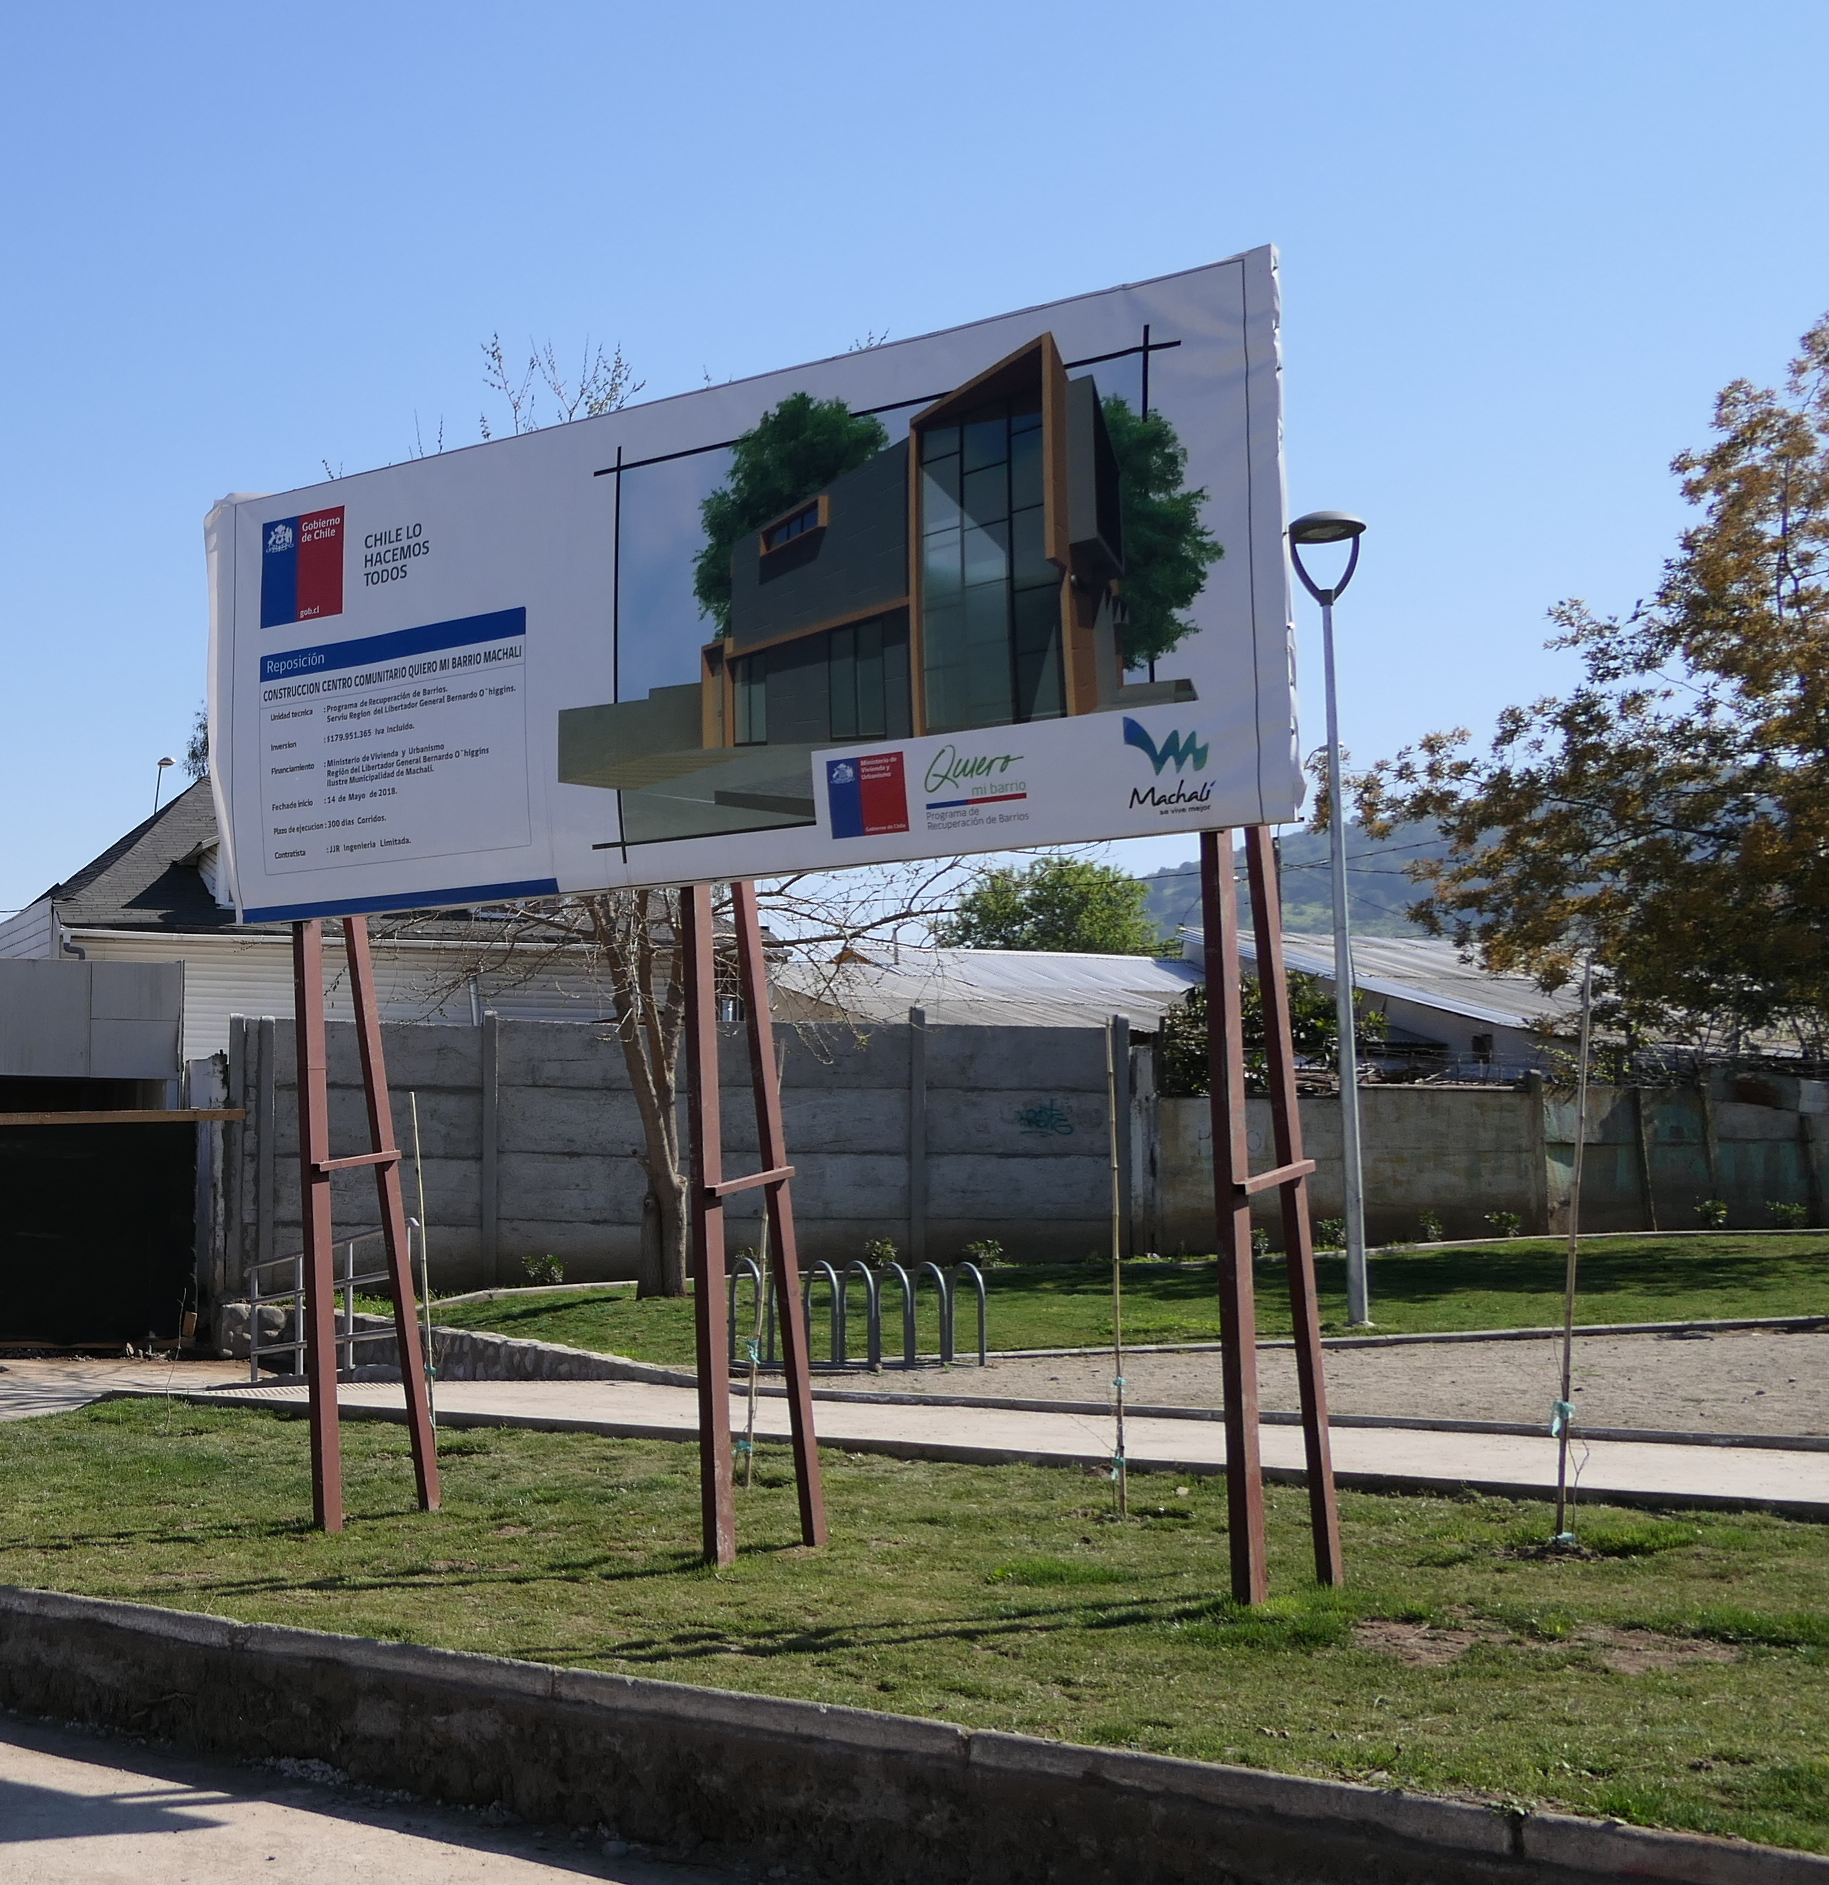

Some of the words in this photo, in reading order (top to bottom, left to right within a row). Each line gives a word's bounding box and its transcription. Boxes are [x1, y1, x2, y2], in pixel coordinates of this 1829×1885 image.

[301, 532, 312, 542] de
[313, 528, 336, 540] Chile
[302, 517, 340, 532] Gobierno
[364, 527, 402, 549] CHILE
[406, 523, 422, 542] LO
[364, 541, 430, 568] HACEMOS
[364, 564, 408, 587] TODOS
[299, 606, 320, 618] gob.cl
[263, 681, 321, 702] CONSTRUCCION
[321, 678, 353, 692] CENTRO
[354, 666, 407, 687] COMUNITARIO
[408, 660, 438, 679] QUIERO
[439, 658, 450, 671] MI
[451, 652, 482, 669] BARRIO
[483, 645, 522, 663] MACHALI
[266, 652, 325, 674] Reposición
[326, 713, 348, 723] Serviu
[373, 707, 384, 716] del
[384, 702, 418, 713] Libertador
[419, 696, 445, 707] General
[446, 691, 478, 703] Bernardo
[359, 700, 368, 708] de
[368, 692, 411, 706] Recuperación
[412, 689, 421, 698] de
[422, 686, 448, 696] Barrios.
[374, 728, 385, 736] Iva
[271, 763, 315, 775] Financiamiento
[361, 754, 370, 762] de
[370, 749, 399, 761] Vivienda
[401, 749, 407, 758] y
[408, 743, 445, 755] Urbanismo
[350, 766, 361, 774] del
[361, 760, 395, 773] Libertador
[395, 757, 422, 767] General
[422, 752, 454, 763] Bernardo
[924, 744, 1025, 793] Quiero
[326, 778, 349, 787] Ilustre
[349, 771, 395, 784] Municipalidad
[395, 769, 405, 777] de
[972, 783, 988, 797] mi
[989, 781, 1027, 795] barrio
[337, 794, 347, 803] de
[347, 793, 366, 801] Mayo
[369, 790, 378, 798] de
[378, 787, 398, 797] 2018.
[1128, 779, 1217, 810] Machalí
[926, 809, 967, 821] Programa
[968, 807, 980, 817] de
[1170, 806, 1188, 815] vive
[1188, 804, 1212, 813] mejor
[288, 825, 296, 834] de
[357, 814, 387, 825] Corridos.
[927, 818, 985, 831] Recuperación
[985, 816, 998, 825] de
[998, 812, 1030, 824] Barrios
[274, 849, 307, 860] Contratista
[379, 836, 412, 848] Limitada.
